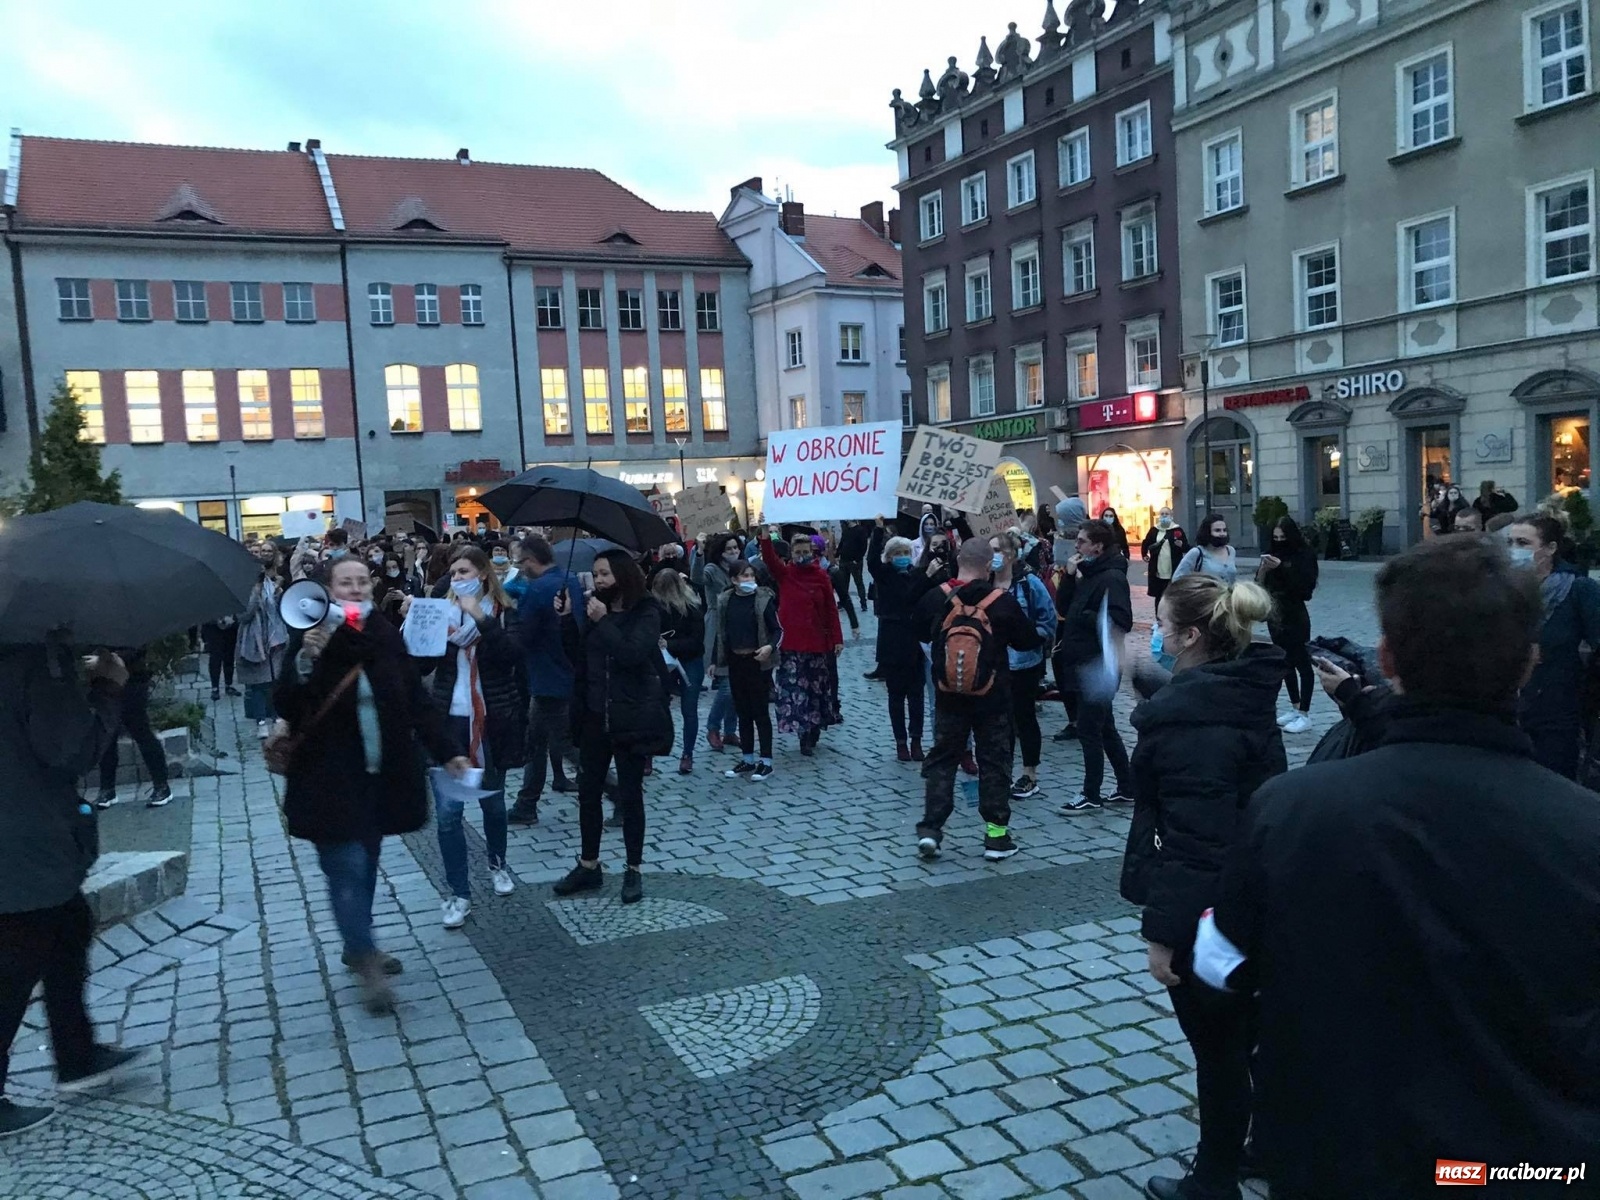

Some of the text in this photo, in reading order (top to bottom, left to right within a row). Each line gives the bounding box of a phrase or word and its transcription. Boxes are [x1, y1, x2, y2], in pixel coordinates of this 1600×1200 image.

[1336, 369, 1403, 399] SHIRO
[974, 416, 1037, 440] KANTOR
[771, 429, 887, 464] W OBRONIE
[923, 431, 978, 458] TWÓJ
[919, 451, 994, 479] BÓL JEST
[772, 461, 879, 499] WOLNOŚCI
[905, 481, 936, 497] NIŻ
[911, 467, 975, 491] LEPSZY
